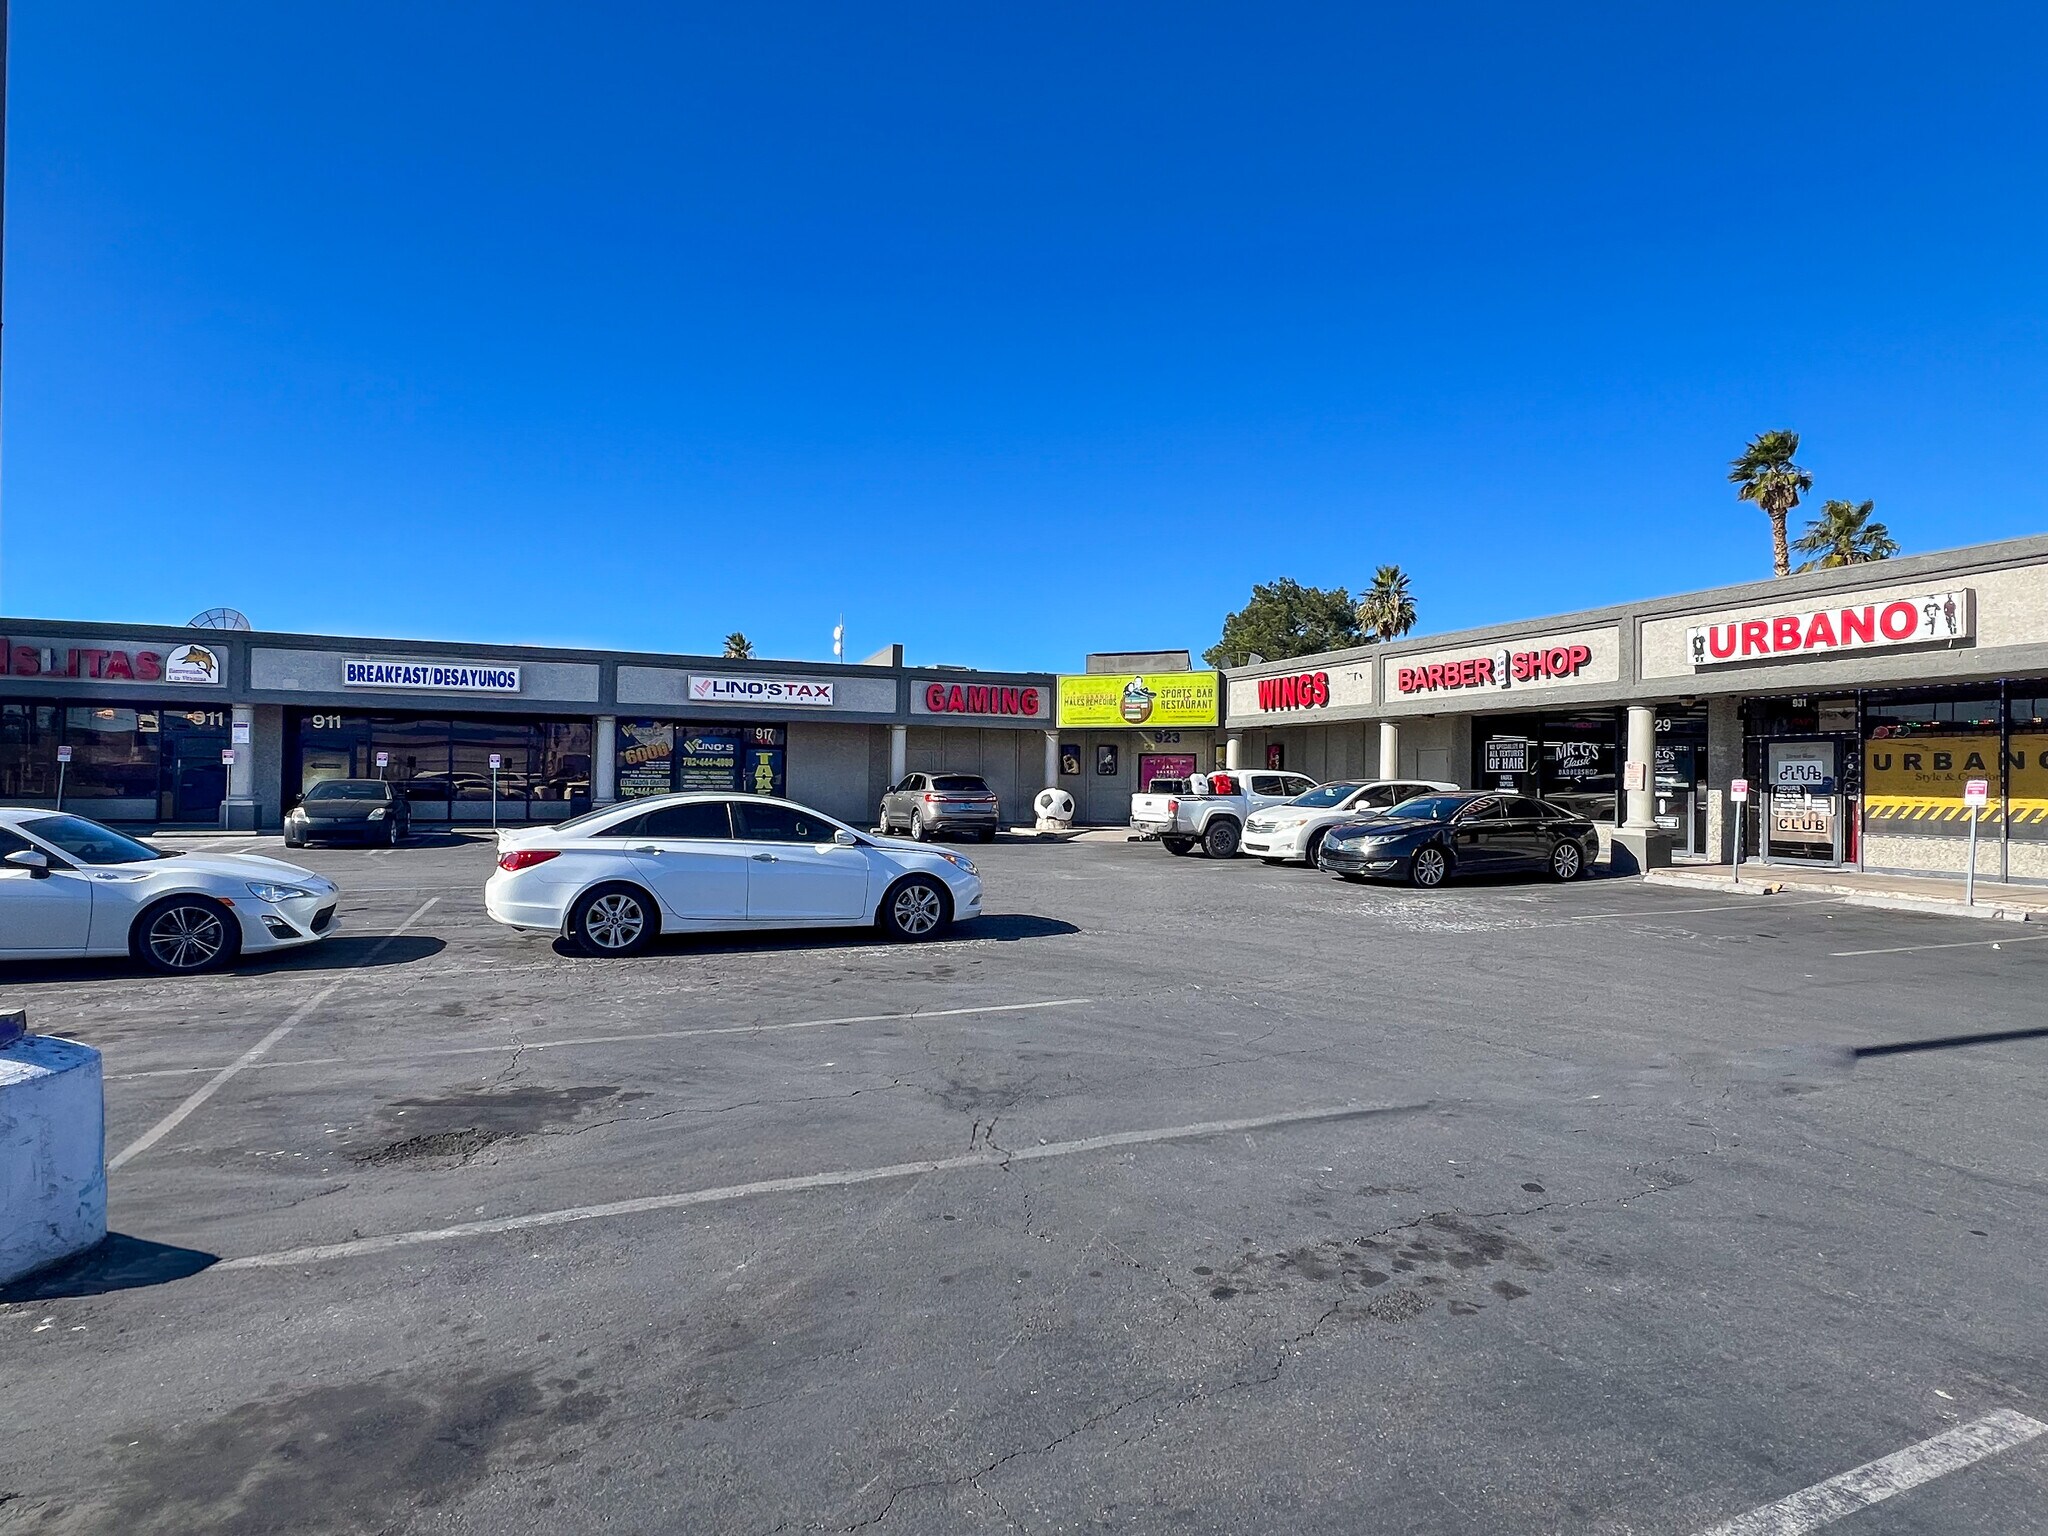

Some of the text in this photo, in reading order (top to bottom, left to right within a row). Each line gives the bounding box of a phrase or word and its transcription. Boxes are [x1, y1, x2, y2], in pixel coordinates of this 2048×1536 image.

[1709, 601, 1919, 659] URBANO
[347, 663, 516, 688] BREAKFAST/DESAYUNOS
[1398, 645, 1591, 692] BARBER SHOP
[713, 680, 782, 696] LINO'S
[784, 684, 830, 698] TAX
[1161, 688, 1192, 699] SPORTS
[1196, 688, 1213, 698] BAR
[1258, 671, 1329, 712] WINGS
[926, 683, 1039, 715] GAMING
[1160, 699, 1213, 710] RESTAURANT
[1792, 699, 1807, 707] 931
[191, 711, 224, 727] 911
[312, 714, 341, 729] 911
[1655, 719, 1672, 732] 29
[755, 727, 774, 741] 917
[1154, 732, 1181, 743] 923
[1556, 743, 1579, 761] MR.
[1489, 757, 1524, 769] OF HAIR
[1779, 771, 1822, 780] CLUB
[1914, 772, 1941, 783] Style
[1779, 818, 1825, 830] CLUB
